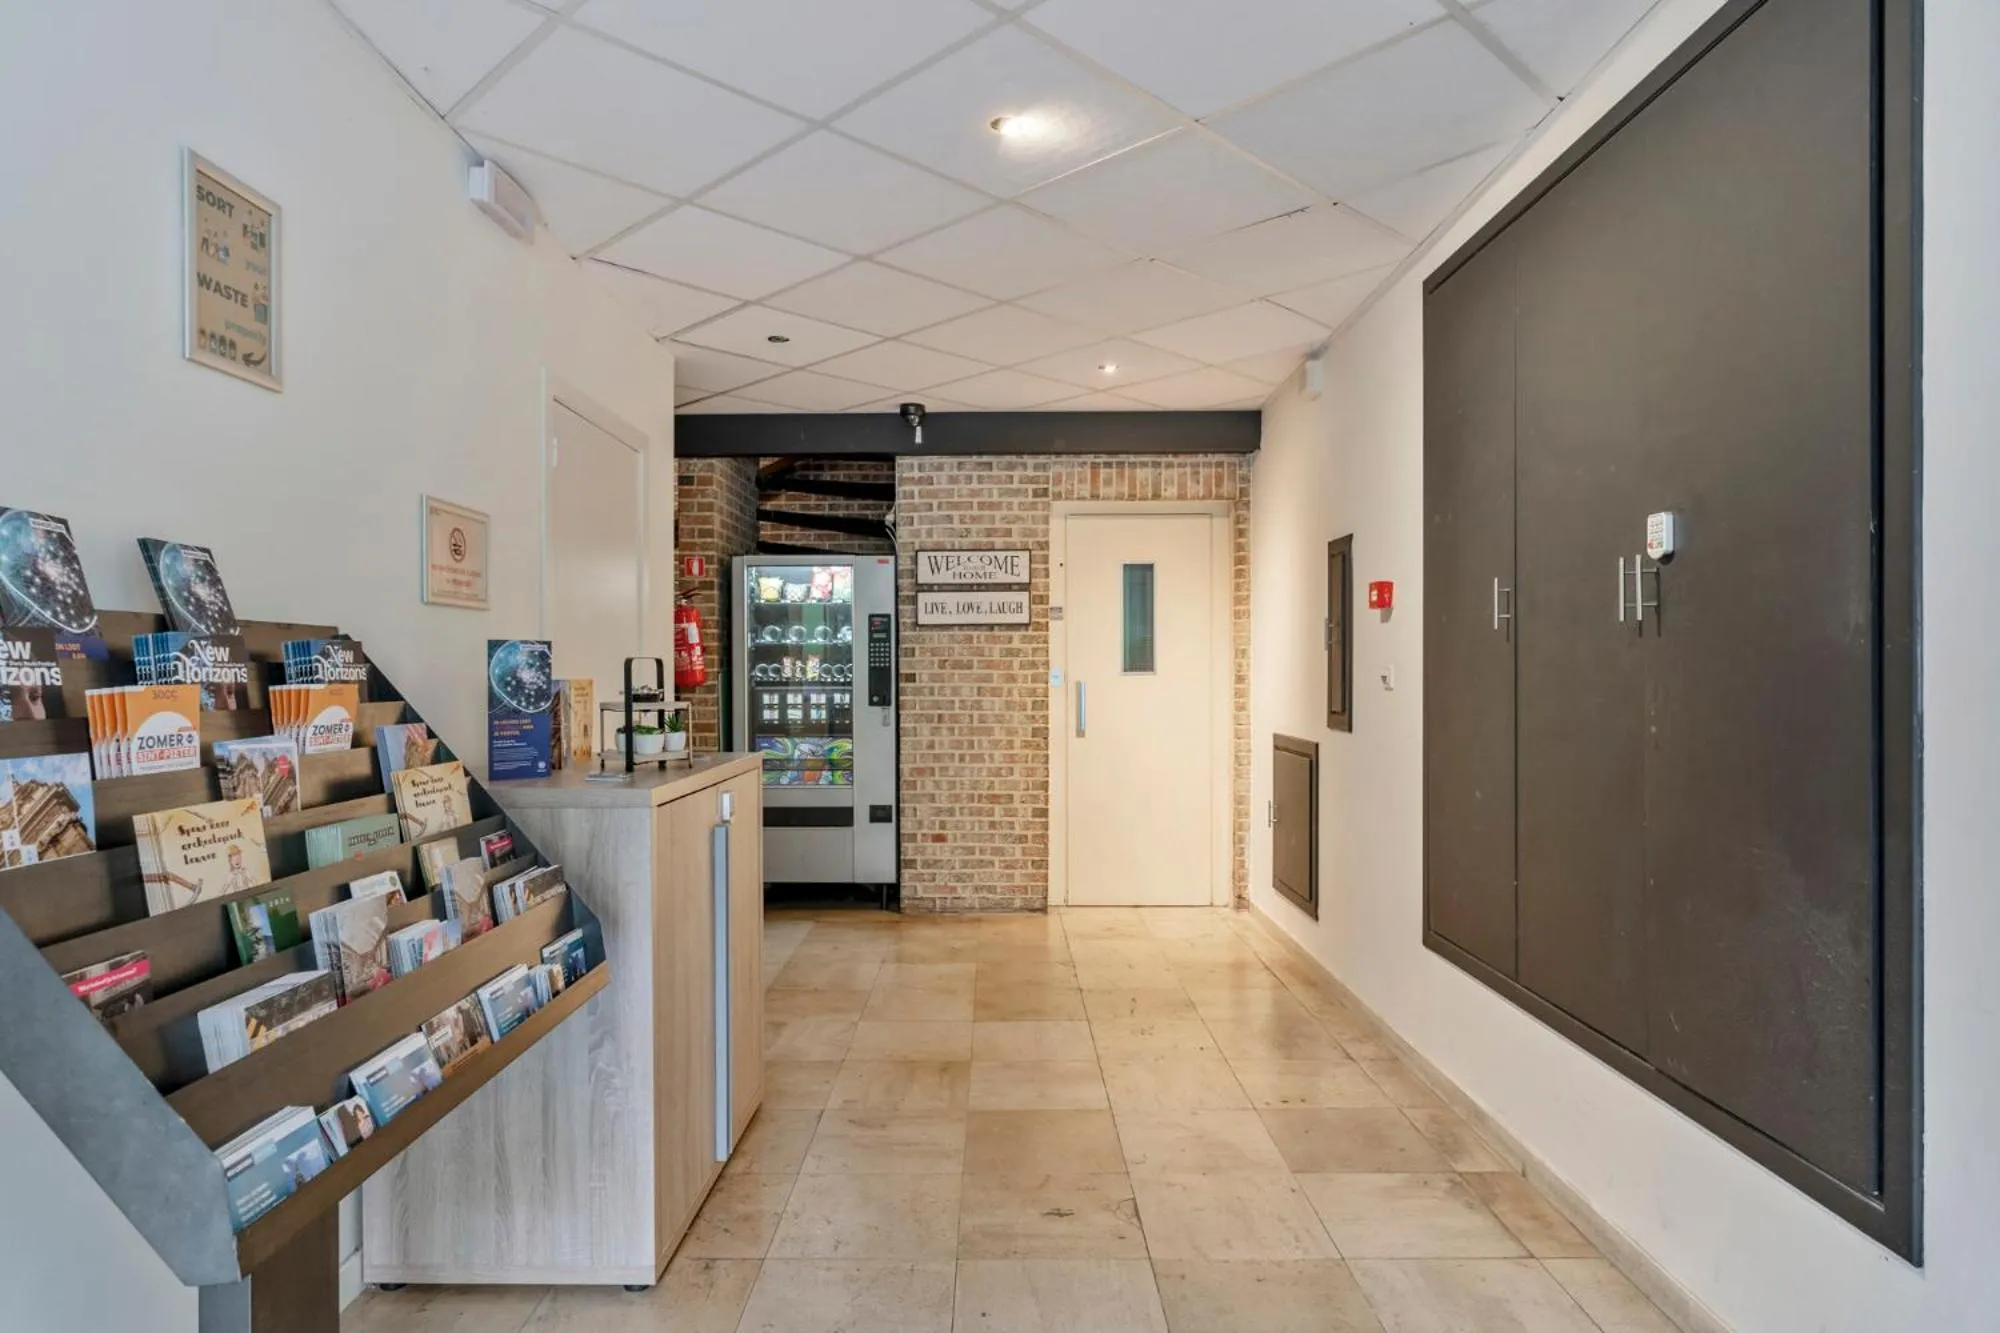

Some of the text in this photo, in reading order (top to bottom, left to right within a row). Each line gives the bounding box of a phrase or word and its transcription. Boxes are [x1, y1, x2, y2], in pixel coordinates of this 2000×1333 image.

[196, 184, 236, 219] SORT
[196, 271, 249, 309] WASTE
[927, 555, 1021, 577] WELCOME
[952, 571, 997, 581] HOME
[924, 601, 953, 617] LIVE,
[989, 600, 1024, 615] LAUGH
[0, 640, 32, 660] ew
[188, 639, 230, 666] New
[325, 645, 354, 666] New
[0, 660, 63, 685] izons
[169, 652, 248, 683] Horizons
[312, 724, 345, 737] ZOMER
[137, 734, 184, 750] ZOMER
